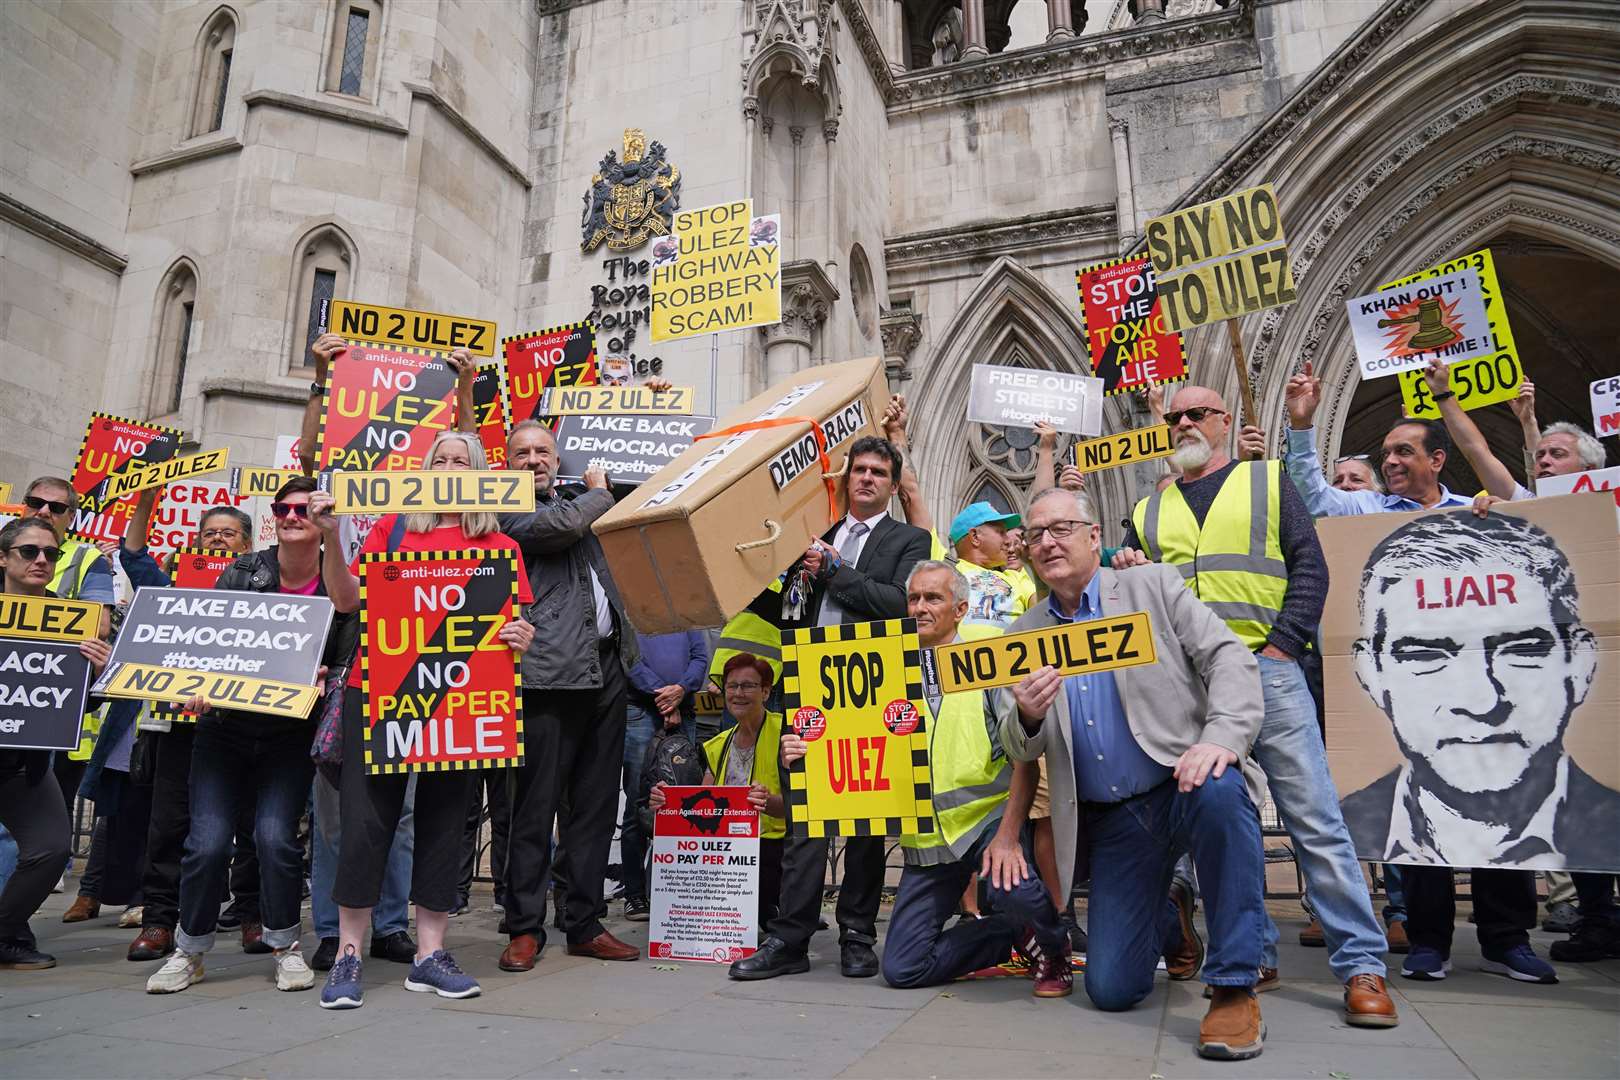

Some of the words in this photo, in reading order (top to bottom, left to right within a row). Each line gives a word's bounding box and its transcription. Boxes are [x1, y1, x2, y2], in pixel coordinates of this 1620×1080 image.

[678, 202, 746, 231] STOP
[679, 227, 744, 254] ULEZ
[1149, 206, 1212, 272] SAY
[1223, 189, 1277, 249] NO
[603, 257, 650, 280] The
[654, 245, 777, 285] HIGHWAY
[591, 284, 650, 306] Roya
[652, 271, 779, 311] ROBBERY
[1157, 273, 1208, 331] TO
[1214, 249, 1297, 315] ULEZ
[1360, 292, 1411, 315] KHAN
[1417, 281, 1455, 299] OUT
[320, 299, 328, 327] #together
[669, 302, 753, 334] SCAM!
[1106, 298, 1150, 323] THE
[342, 307, 379, 336] NO
[387, 314, 406, 340] 2
[414, 317, 486, 350] ULEZ
[526, 332, 581, 349] anti-ulez.com
[608, 327, 636, 352] of
[1093, 314, 1168, 347] TOXIC
[365, 352, 443, 371] anti-ulez.com
[534, 348, 565, 369] NO
[1115, 339, 1159, 366] AIR
[1366, 351, 1425, 372] COURT
[1431, 339, 1477, 358] TIME
[372, 367, 417, 392] NO
[989, 370, 1038, 388] FREE
[1044, 377, 1087, 394] OUR
[1121, 360, 1158, 383] LIE
[1413, 353, 1518, 414] £500
[336, 387, 448, 429] ULEZ
[560, 391, 592, 410] NO
[600, 391, 613, 410] 2
[620, 391, 683, 410] ULEZ
[994, 389, 1077, 412] STREETS
[580, 416, 628, 433] TAKE
[636, 418, 696, 437] BACK
[1001, 407, 1067, 425] #together
[113, 425, 169, 443] anti-ulez.com
[114, 436, 147, 456] NO
[366, 426, 411, 452] NO
[328, 447, 380, 471] PAY
[387, 454, 423, 471] PE
[486, 446, 505, 464] ER
[565, 436, 690, 459] DEMOCRAC
[1085, 442, 1111, 467] NO
[1118, 438, 1131, 459] 2
[1137, 430, 1172, 455] UL
[85, 450, 149, 475] ULE
[115, 472, 142, 493] NO
[147, 467, 160, 484] 2
[165, 452, 221, 479] ULEZ
[250, 473, 279, 491] NO
[346, 478, 390, 507] NO
[402, 478, 422, 505] 2
[434, 477, 520, 505] ULEZ
[163, 485, 249, 506] CRAP
[112, 502, 136, 519] PE
[158, 508, 200, 526] UL
[69, 509, 130, 540] MIL
[401, 566, 495, 578] anti-ulez.com
[414, 585, 466, 612] NO
[1415, 573, 1519, 610] LIAR
[157, 597, 225, 617] TAKE
[230, 600, 310, 623] BACK
[132, 624, 312, 651] DEMOCRACY
[377, 614, 509, 655] ULEZ
[0, 652, 66, 675] ACK
[162, 651, 265, 673] #together
[950, 647, 997, 685] NO
[1010, 642, 1030, 676] 2
[1038, 623, 1139, 670] ULEZ
[418, 660, 470, 690] NO
[924, 650, 934, 685] #together
[124, 669, 176, 693] NO
[177, 675, 205, 697] 2
[208, 678, 301, 710] ULEZ
[820, 652, 884, 710] STOP
[378, 693, 437, 719] PAY
[447, 690, 510, 717] PER
[798, 711, 820, 719] STOP
[884, 711, 917, 723] ULEZ
[889, 704, 911, 712] STOP
[793, 718, 825, 729] ULEZ
[386, 716, 505, 758] MILE
[826, 736, 890, 795] ULEZ
[679, 809, 702, 817] Against
[677, 841, 698, 851] NO
[702, 842, 731, 851] ULEZ
[654, 854, 674, 864] NO
[678, 855, 699, 864] PAY
[703, 855, 724, 865] PER
[728, 856, 757, 866] MILE
